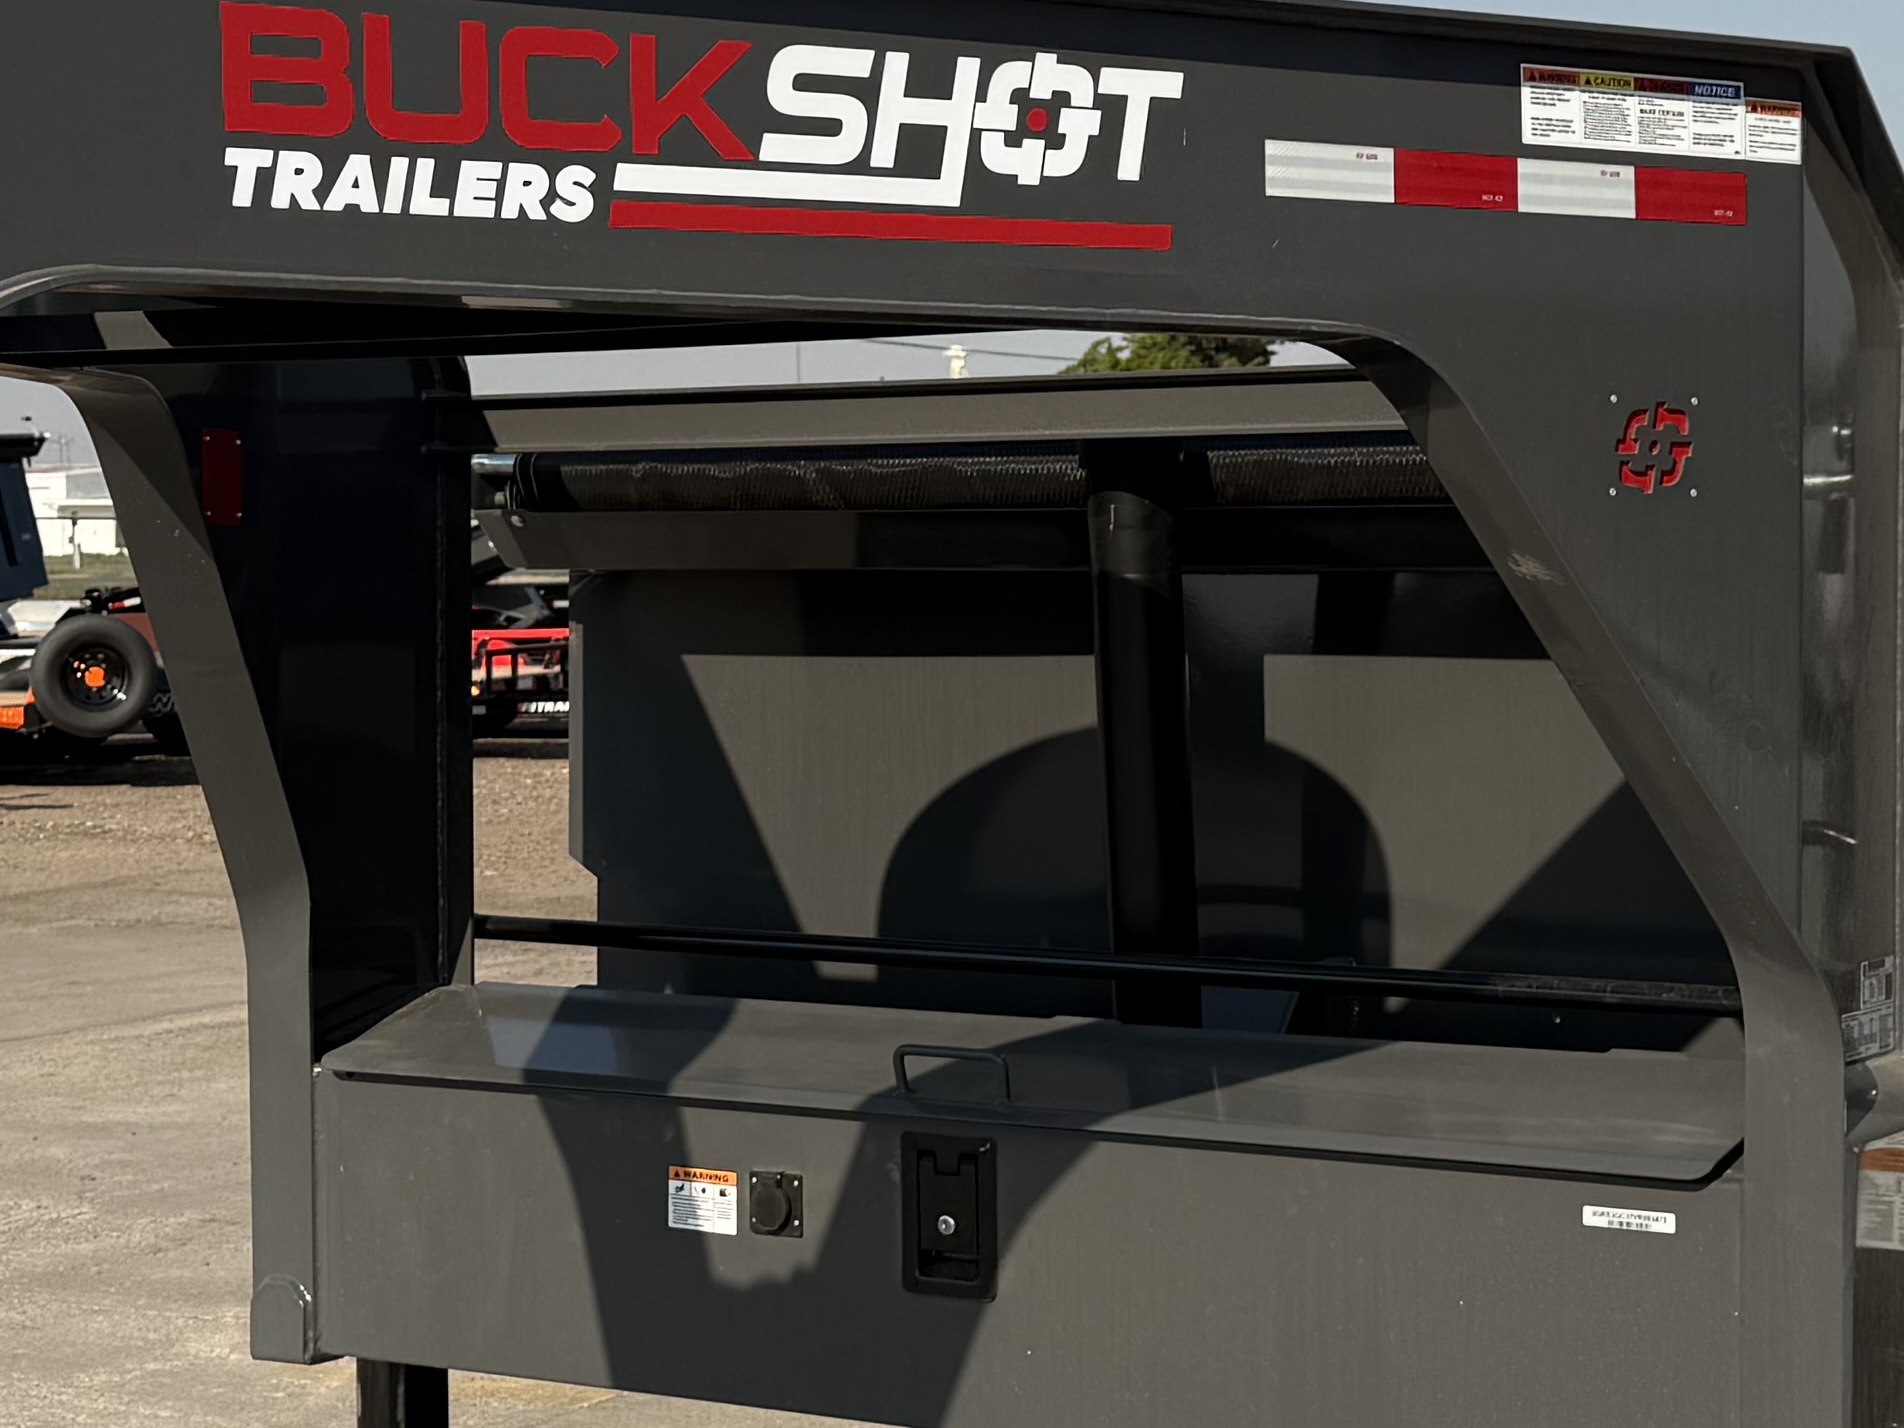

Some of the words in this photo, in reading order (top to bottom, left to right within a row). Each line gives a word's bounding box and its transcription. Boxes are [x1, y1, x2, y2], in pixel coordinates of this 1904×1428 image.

[1593, 75, 1631, 88] CAUTION
[219, 0, 1184, 186] BUCKSHOT
[1695, 84, 1736, 98] NOTICE
[223, 147, 596, 223] TRAILERS
[683, 1170, 729, 1183] WARNING
